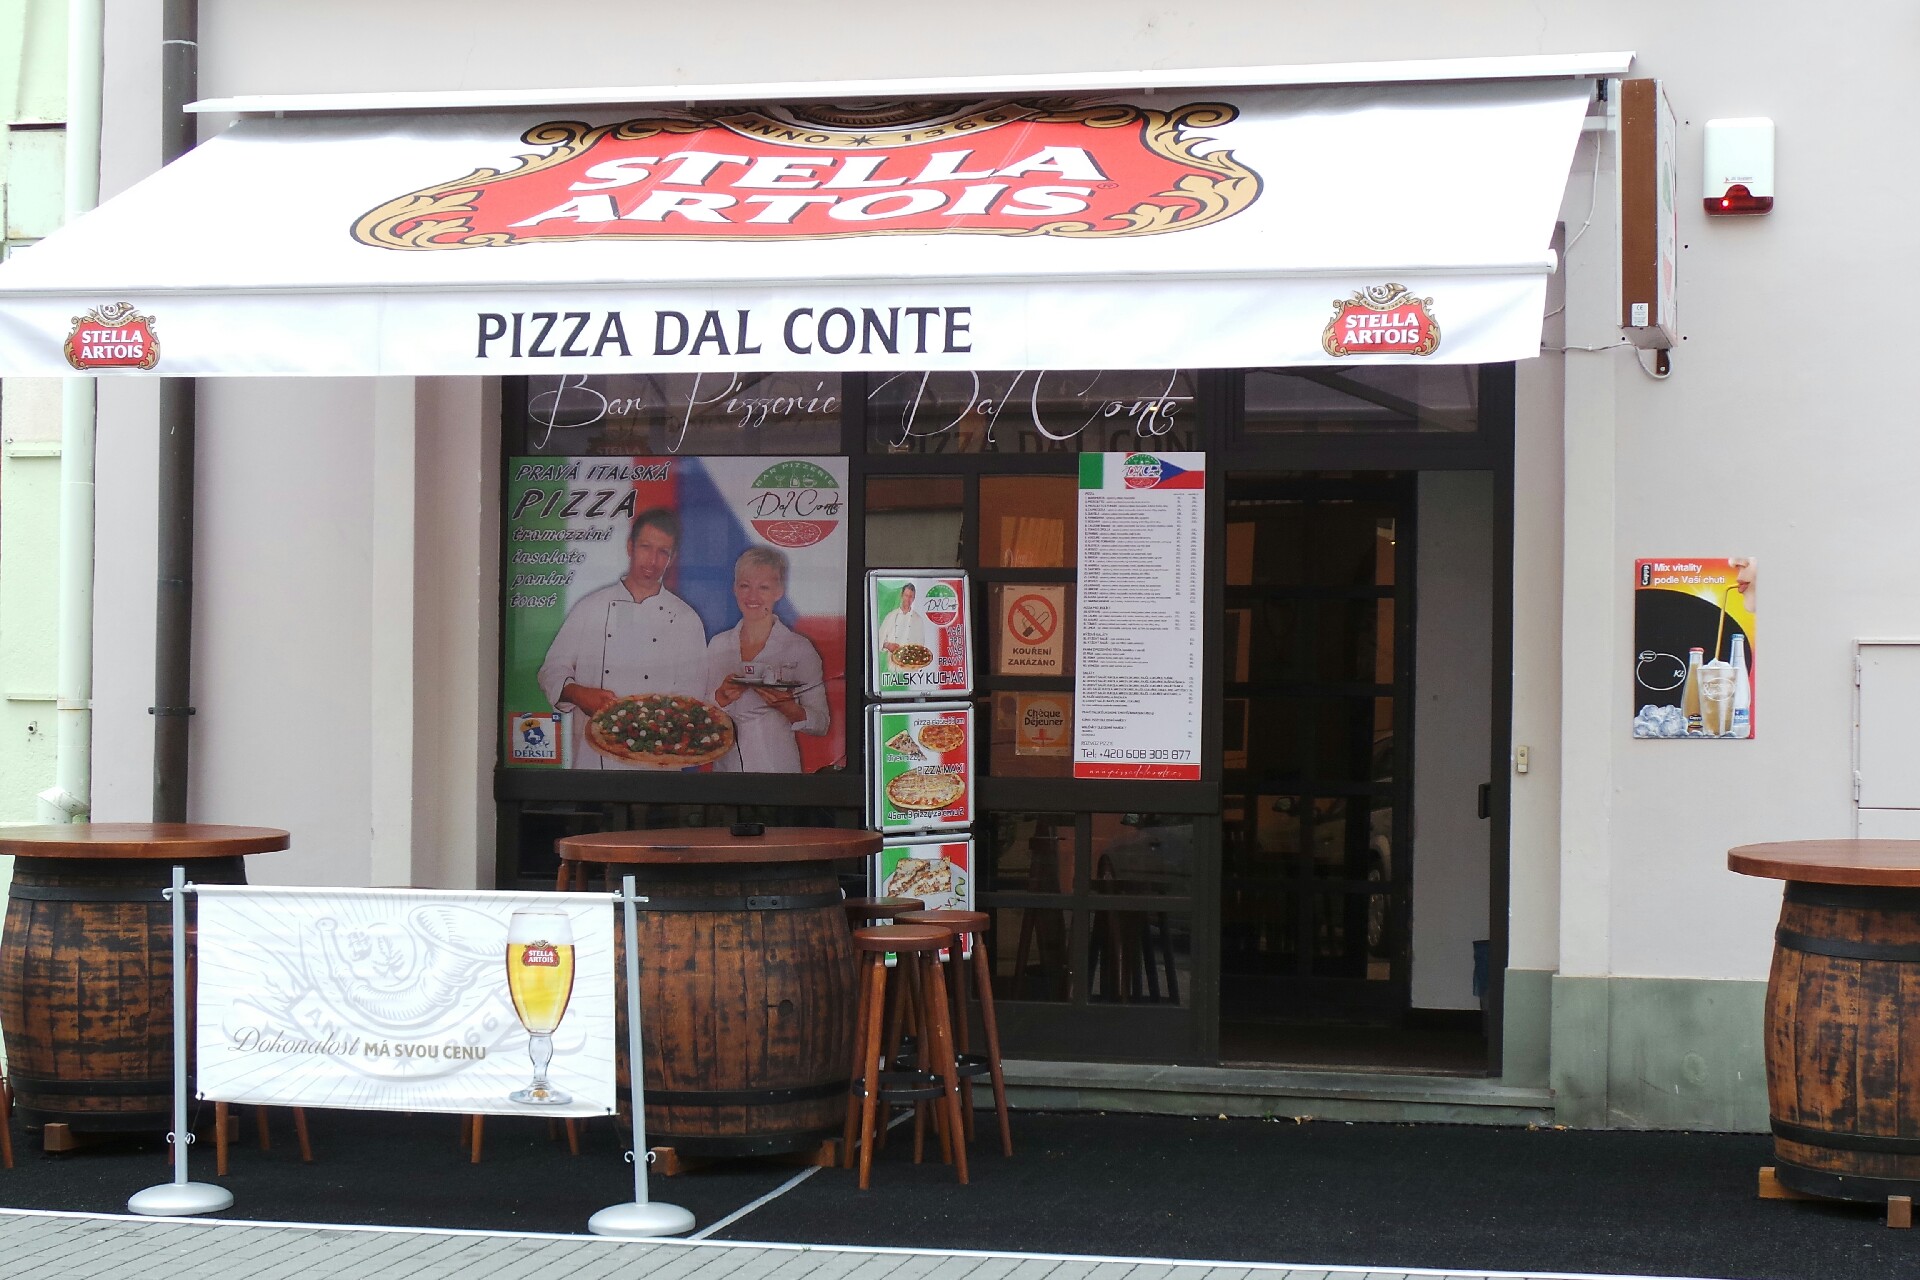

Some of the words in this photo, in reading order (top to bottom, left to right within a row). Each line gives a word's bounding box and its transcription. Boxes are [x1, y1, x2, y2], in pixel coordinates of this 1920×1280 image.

[733, 117, 830, 144] ANNO
[902, 112, 1008, 143] 1366
[568, 145, 1113, 192] STELLA
[508, 184, 1096, 229] ARTOIS
[1345, 312, 1420, 329] STELLA
[81, 330, 144, 344] STELLA
[475, 311, 633, 358] PIZZA
[652, 308, 762, 356] DAL
[783, 306, 973, 355] CONTE
[1343, 329, 1420, 344] ARTOIS
[80, 345, 144, 359] ARTOIS
[528, 373, 647, 450] Bar
[515, 460, 583, 481] PRAVÁ
[586, 461, 672, 481] ITALSKÁ
[511, 487, 638, 520] PIZZA
[1654, 563, 1670, 572] Mix
[1672, 563, 1703, 573] vitality
[510, 570, 576, 591] panini
[1654, 576, 1680, 586] podle
[509, 592, 558, 608] toast
[1012, 647, 1052, 656] KOUŘENÍ
[1007, 658, 1056, 667] ZAKÁZÁNO
[881, 669, 924, 686] ITALSKÝ
[925, 667, 965, 685] KUCHAŘ
[514, 749, 555, 758] DERSUT
[1081, 749, 1097, 759] Tel:
[1100, 749, 1124, 759] +420
[1126, 749, 1147, 760] 608
[1149, 750, 1169, 760] 309
[1171, 750, 1191, 760] 877
[917, 765, 941, 776] PIZZA
[527, 956, 554, 964] ARTOIS
[227, 1025, 361, 1057] Dokonalost
[363, 1039, 391, 1058] MÁ
[393, 1043, 440, 1060] SVOU
[442, 1044, 487, 1061] CENU
